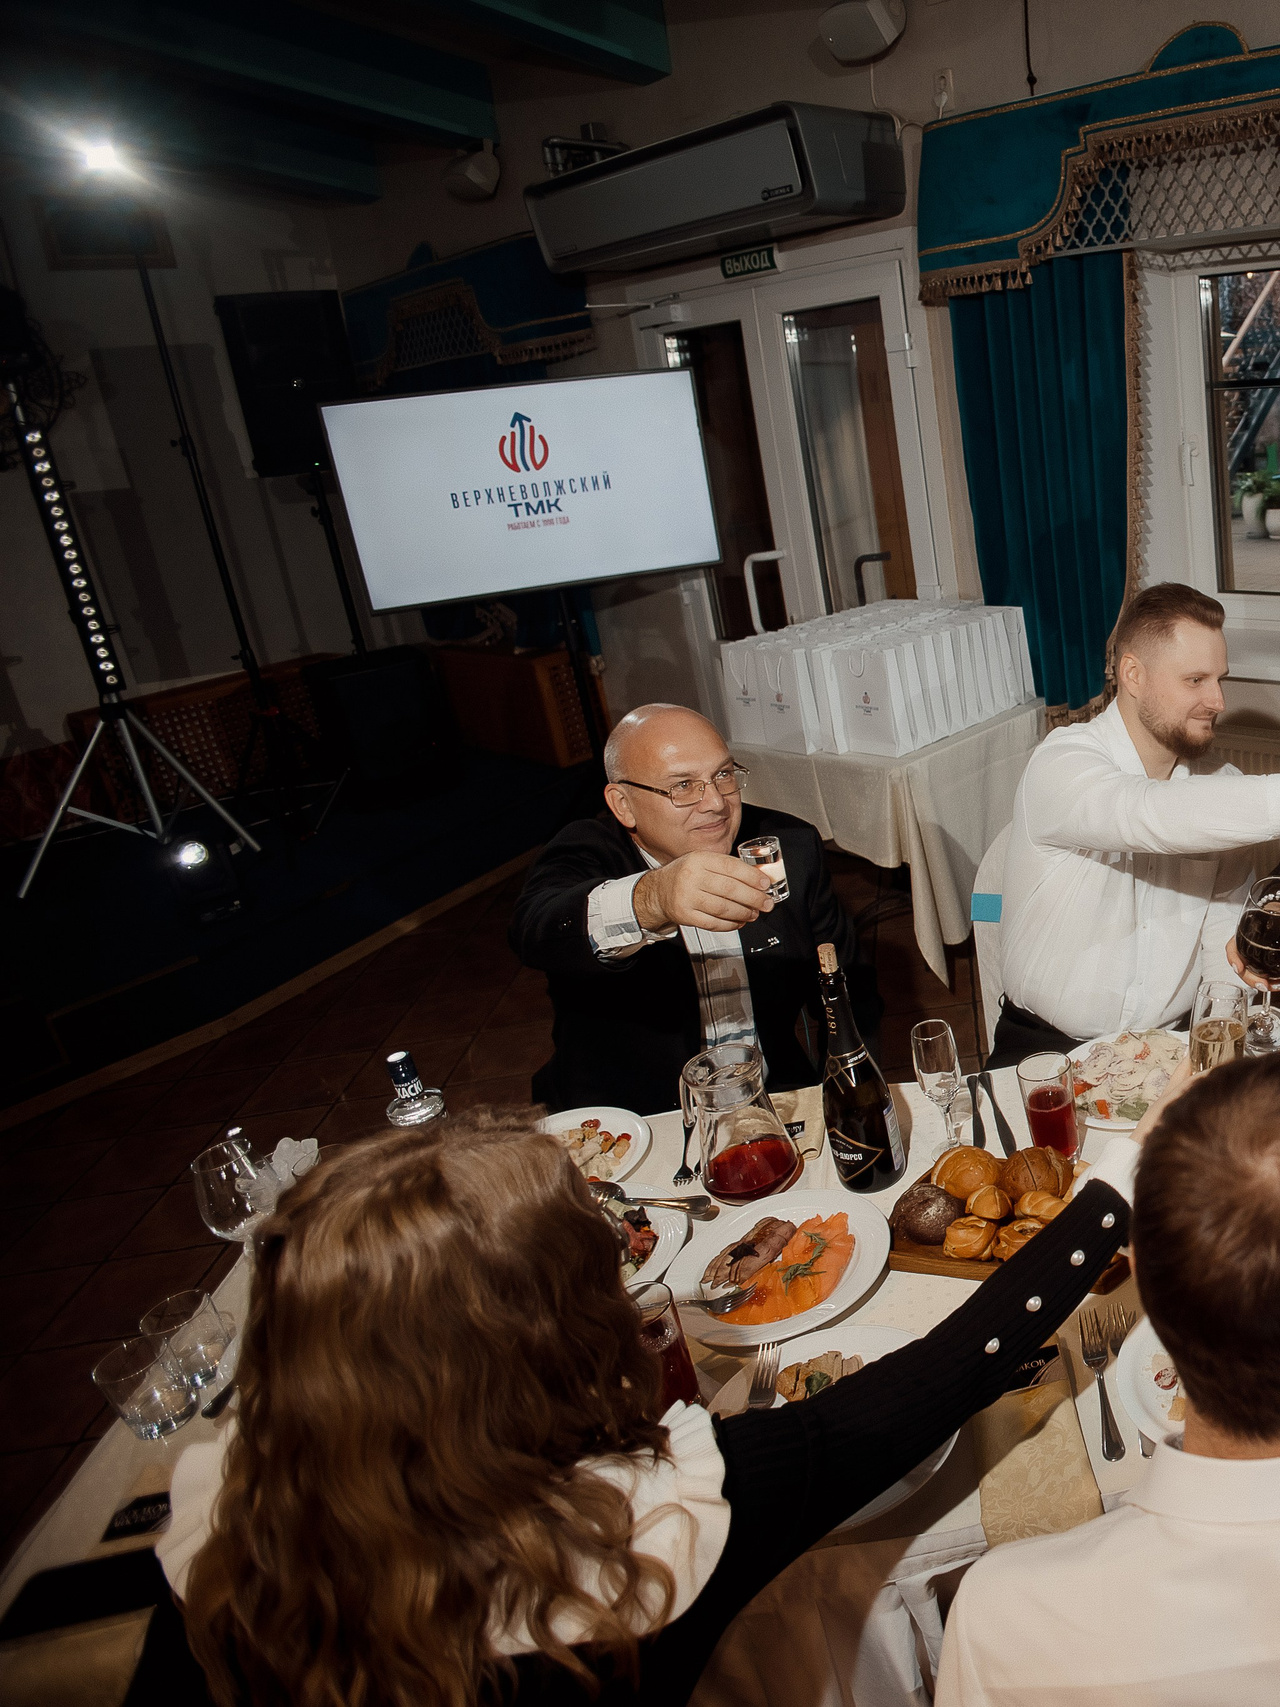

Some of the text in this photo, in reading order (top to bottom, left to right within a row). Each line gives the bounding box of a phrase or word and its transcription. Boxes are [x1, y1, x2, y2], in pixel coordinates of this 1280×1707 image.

[725, 251, 771, 275] ВЫХОД
[450, 471, 612, 509] ВЕРХНЕВОЛЖСКИЙ
[507, 498, 563, 518] ТМК
